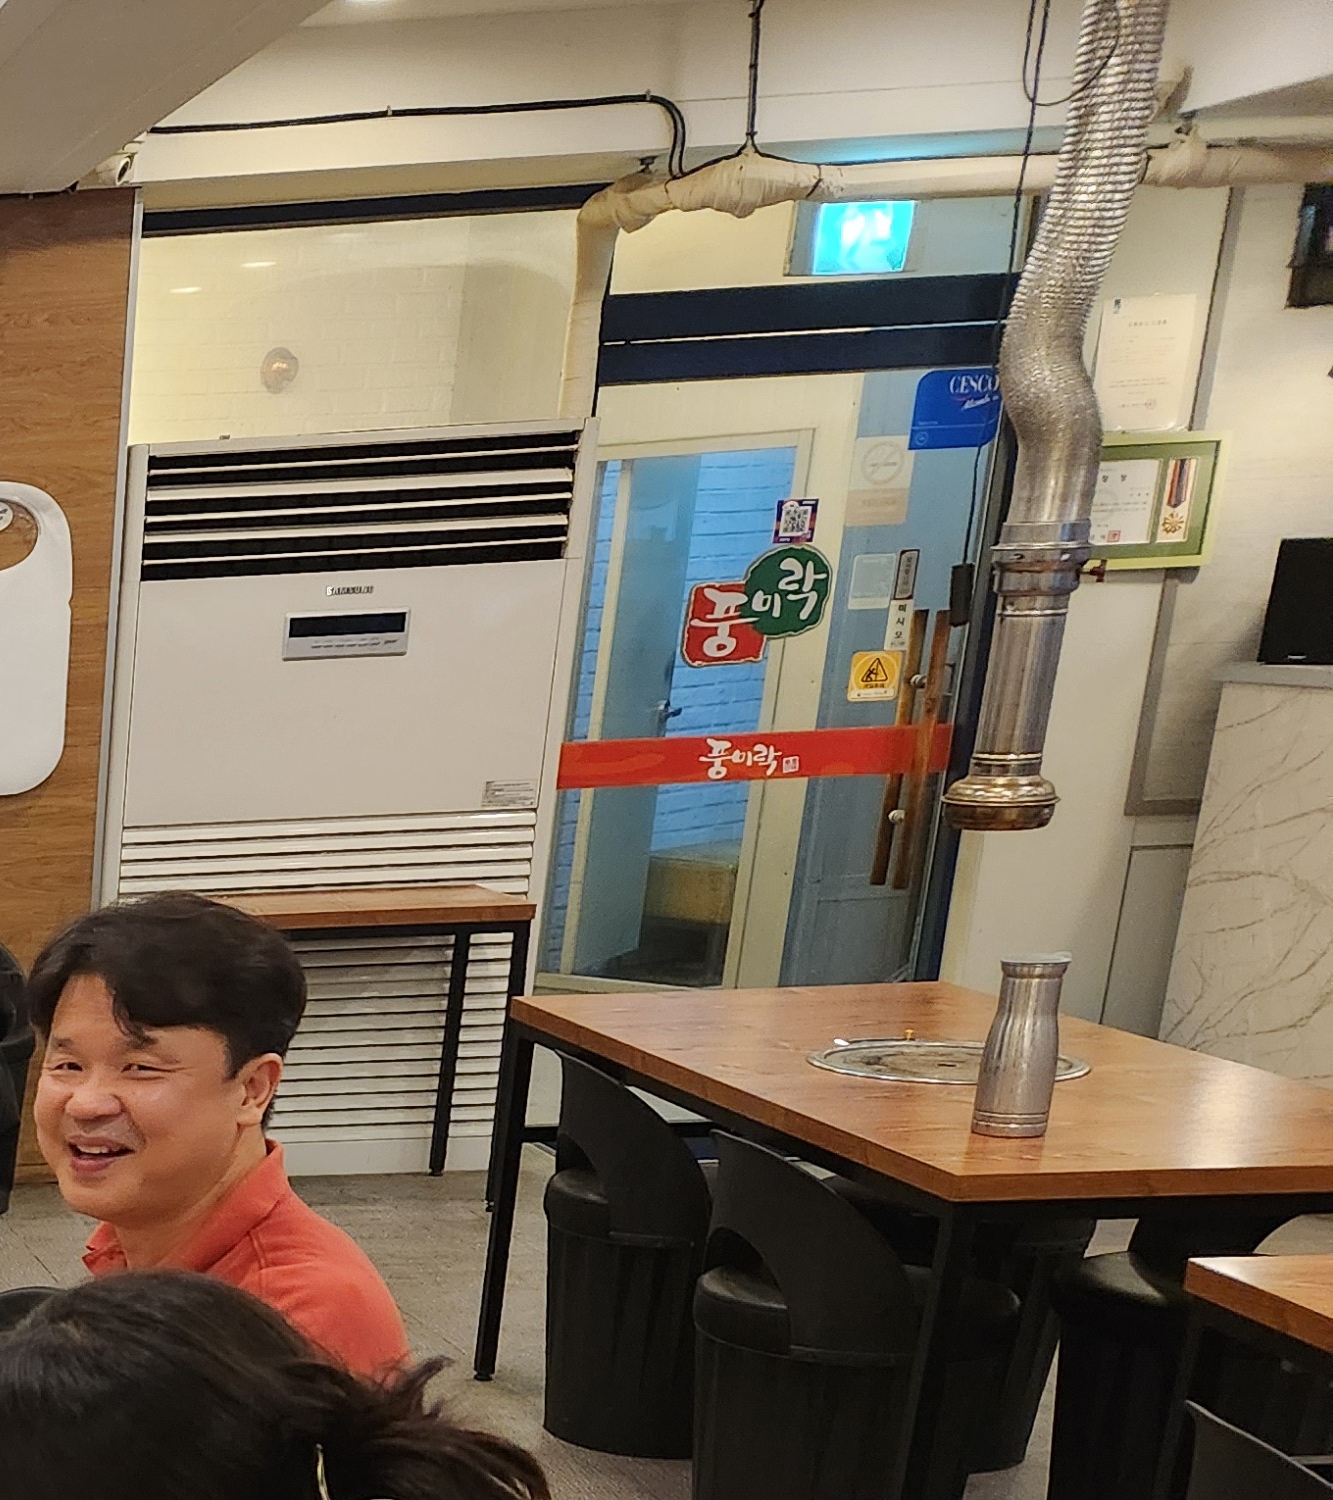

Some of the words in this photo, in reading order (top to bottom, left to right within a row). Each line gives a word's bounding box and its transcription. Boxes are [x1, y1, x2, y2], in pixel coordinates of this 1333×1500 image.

[949, 374, 1000, 394] CESCO
[690, 557, 828, 658] 풍미락
[698, 738, 783, 780] 풍미락
